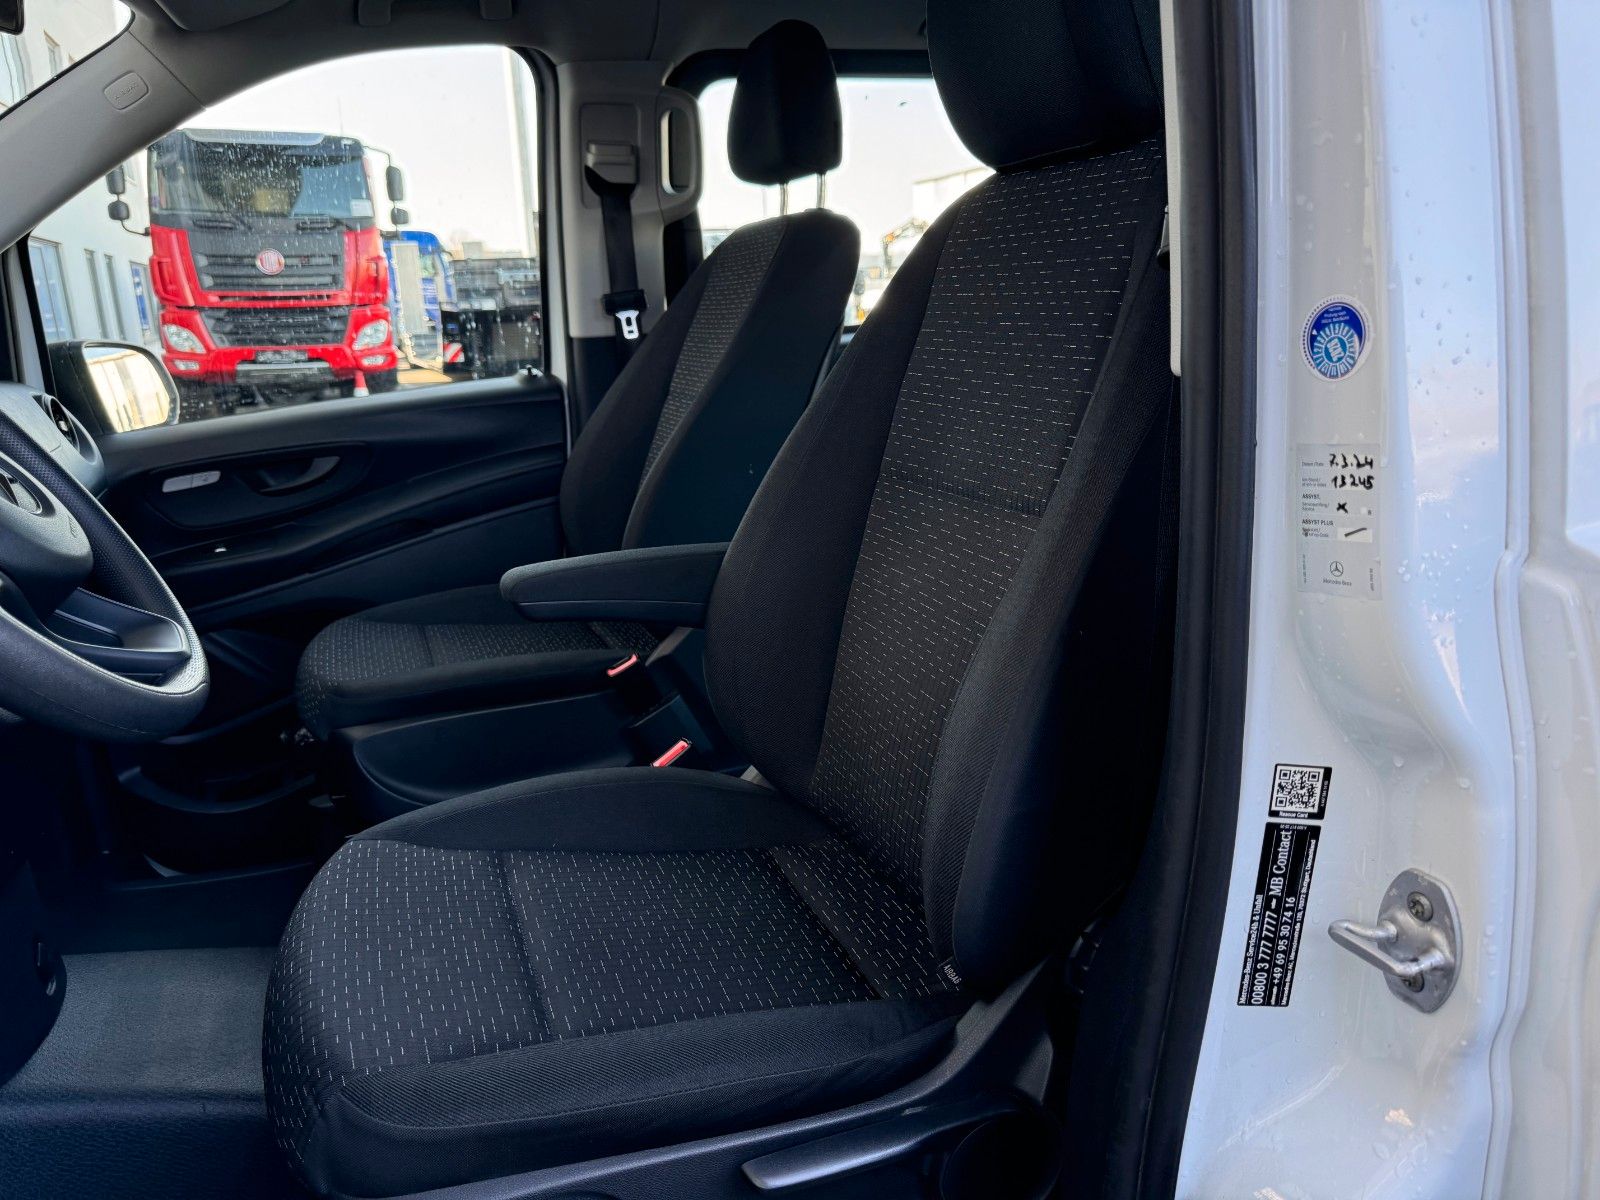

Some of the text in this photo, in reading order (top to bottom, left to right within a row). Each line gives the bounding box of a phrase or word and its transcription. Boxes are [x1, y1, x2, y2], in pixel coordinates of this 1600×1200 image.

[1273, 830, 1292, 874] Contact
[1306, 840, 1316, 870] Deutschland
[1269, 877, 1284, 896] MB
[1285, 896, 1295, 908] 16
[1262, 911, 1278, 937] 7777
[1282, 911, 1293, 923] 74
[1280, 925, 1290, 937] 30
[1239, 958, 1252, 1004] Mercedes-Benz
[1247, 922, 1258, 956] Service24h
[1253, 894, 1263, 914] Unfall
[1258, 940, 1272, 960] 777
[1278, 940, 1288, 951] 95
[1275, 954, 1285, 965] 69
[1273, 967, 1283, 984] +49
[1251, 972, 1267, 1004] 00800
